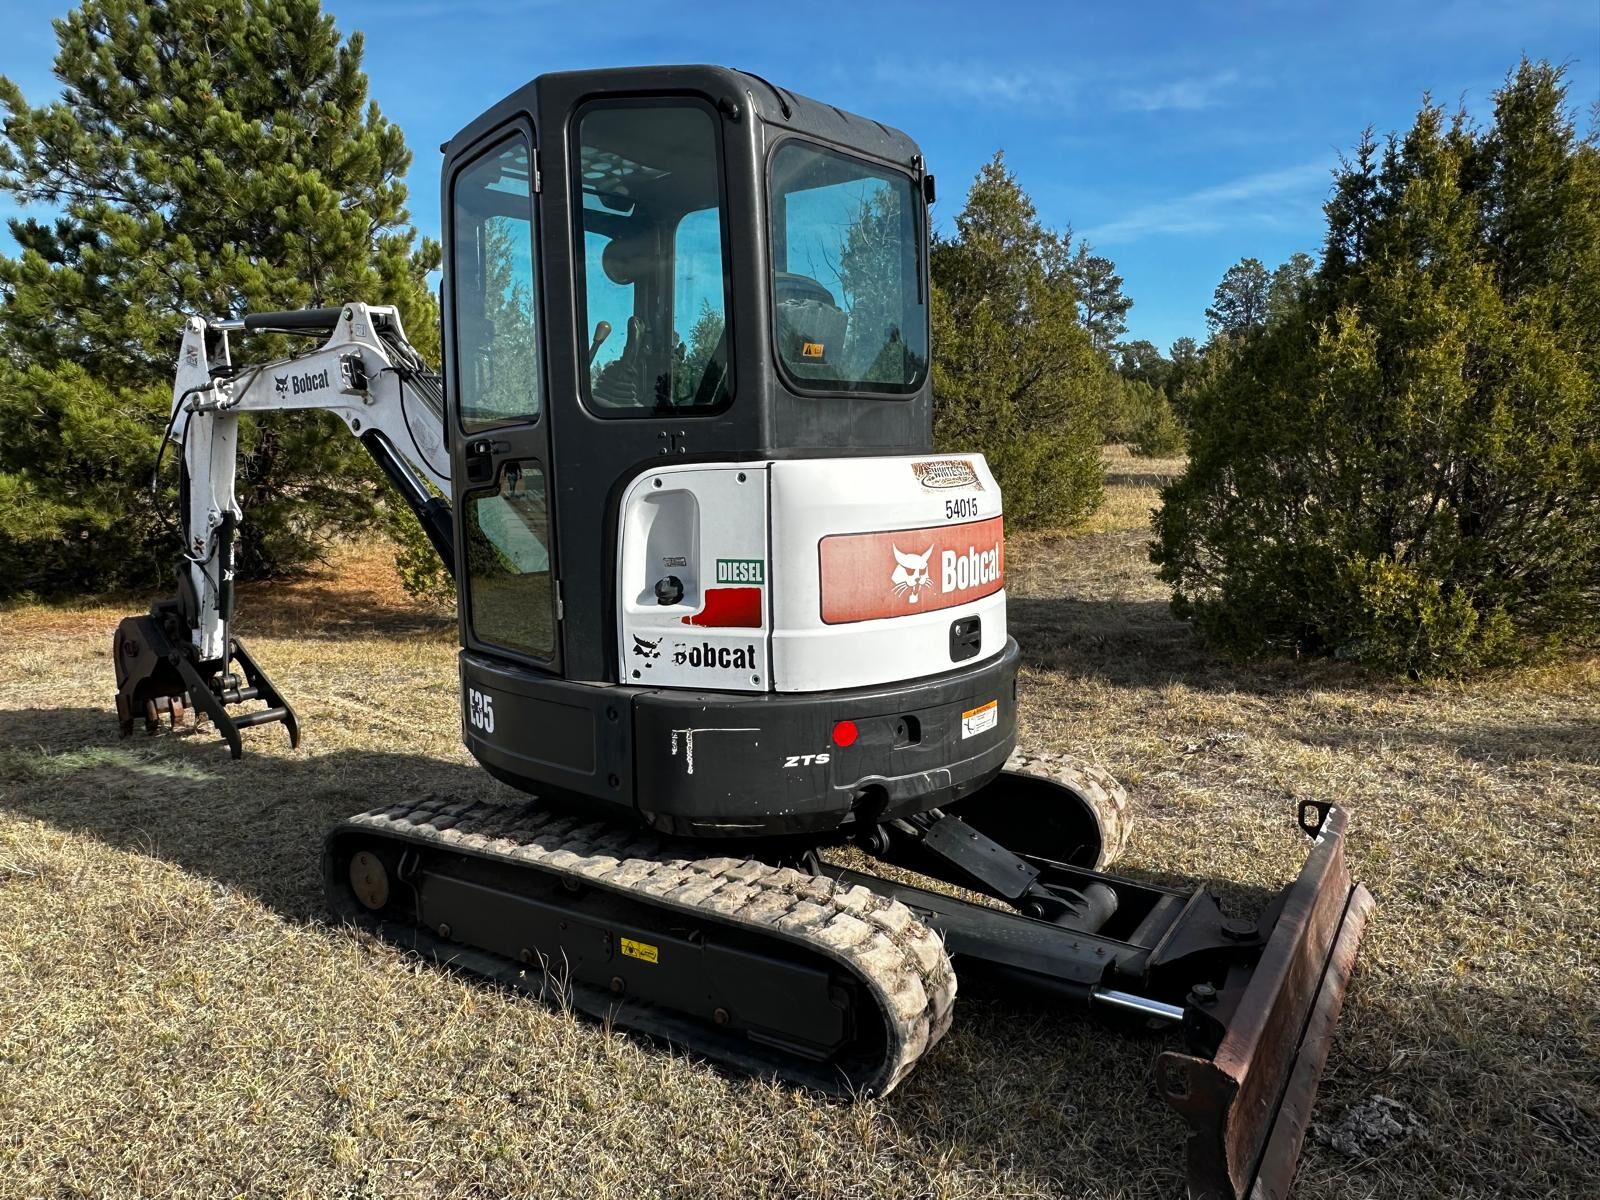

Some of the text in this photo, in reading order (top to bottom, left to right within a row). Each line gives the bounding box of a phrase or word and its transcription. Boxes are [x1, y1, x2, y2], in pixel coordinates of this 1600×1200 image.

[292, 369, 329, 395] Bobcat
[945, 498, 978, 519] 54015
[718, 562, 763, 582] DIESEL
[941, 541, 1001, 593] Bobcat
[469, 687, 495, 733] E35
[783, 753, 830, 768] ZTS
